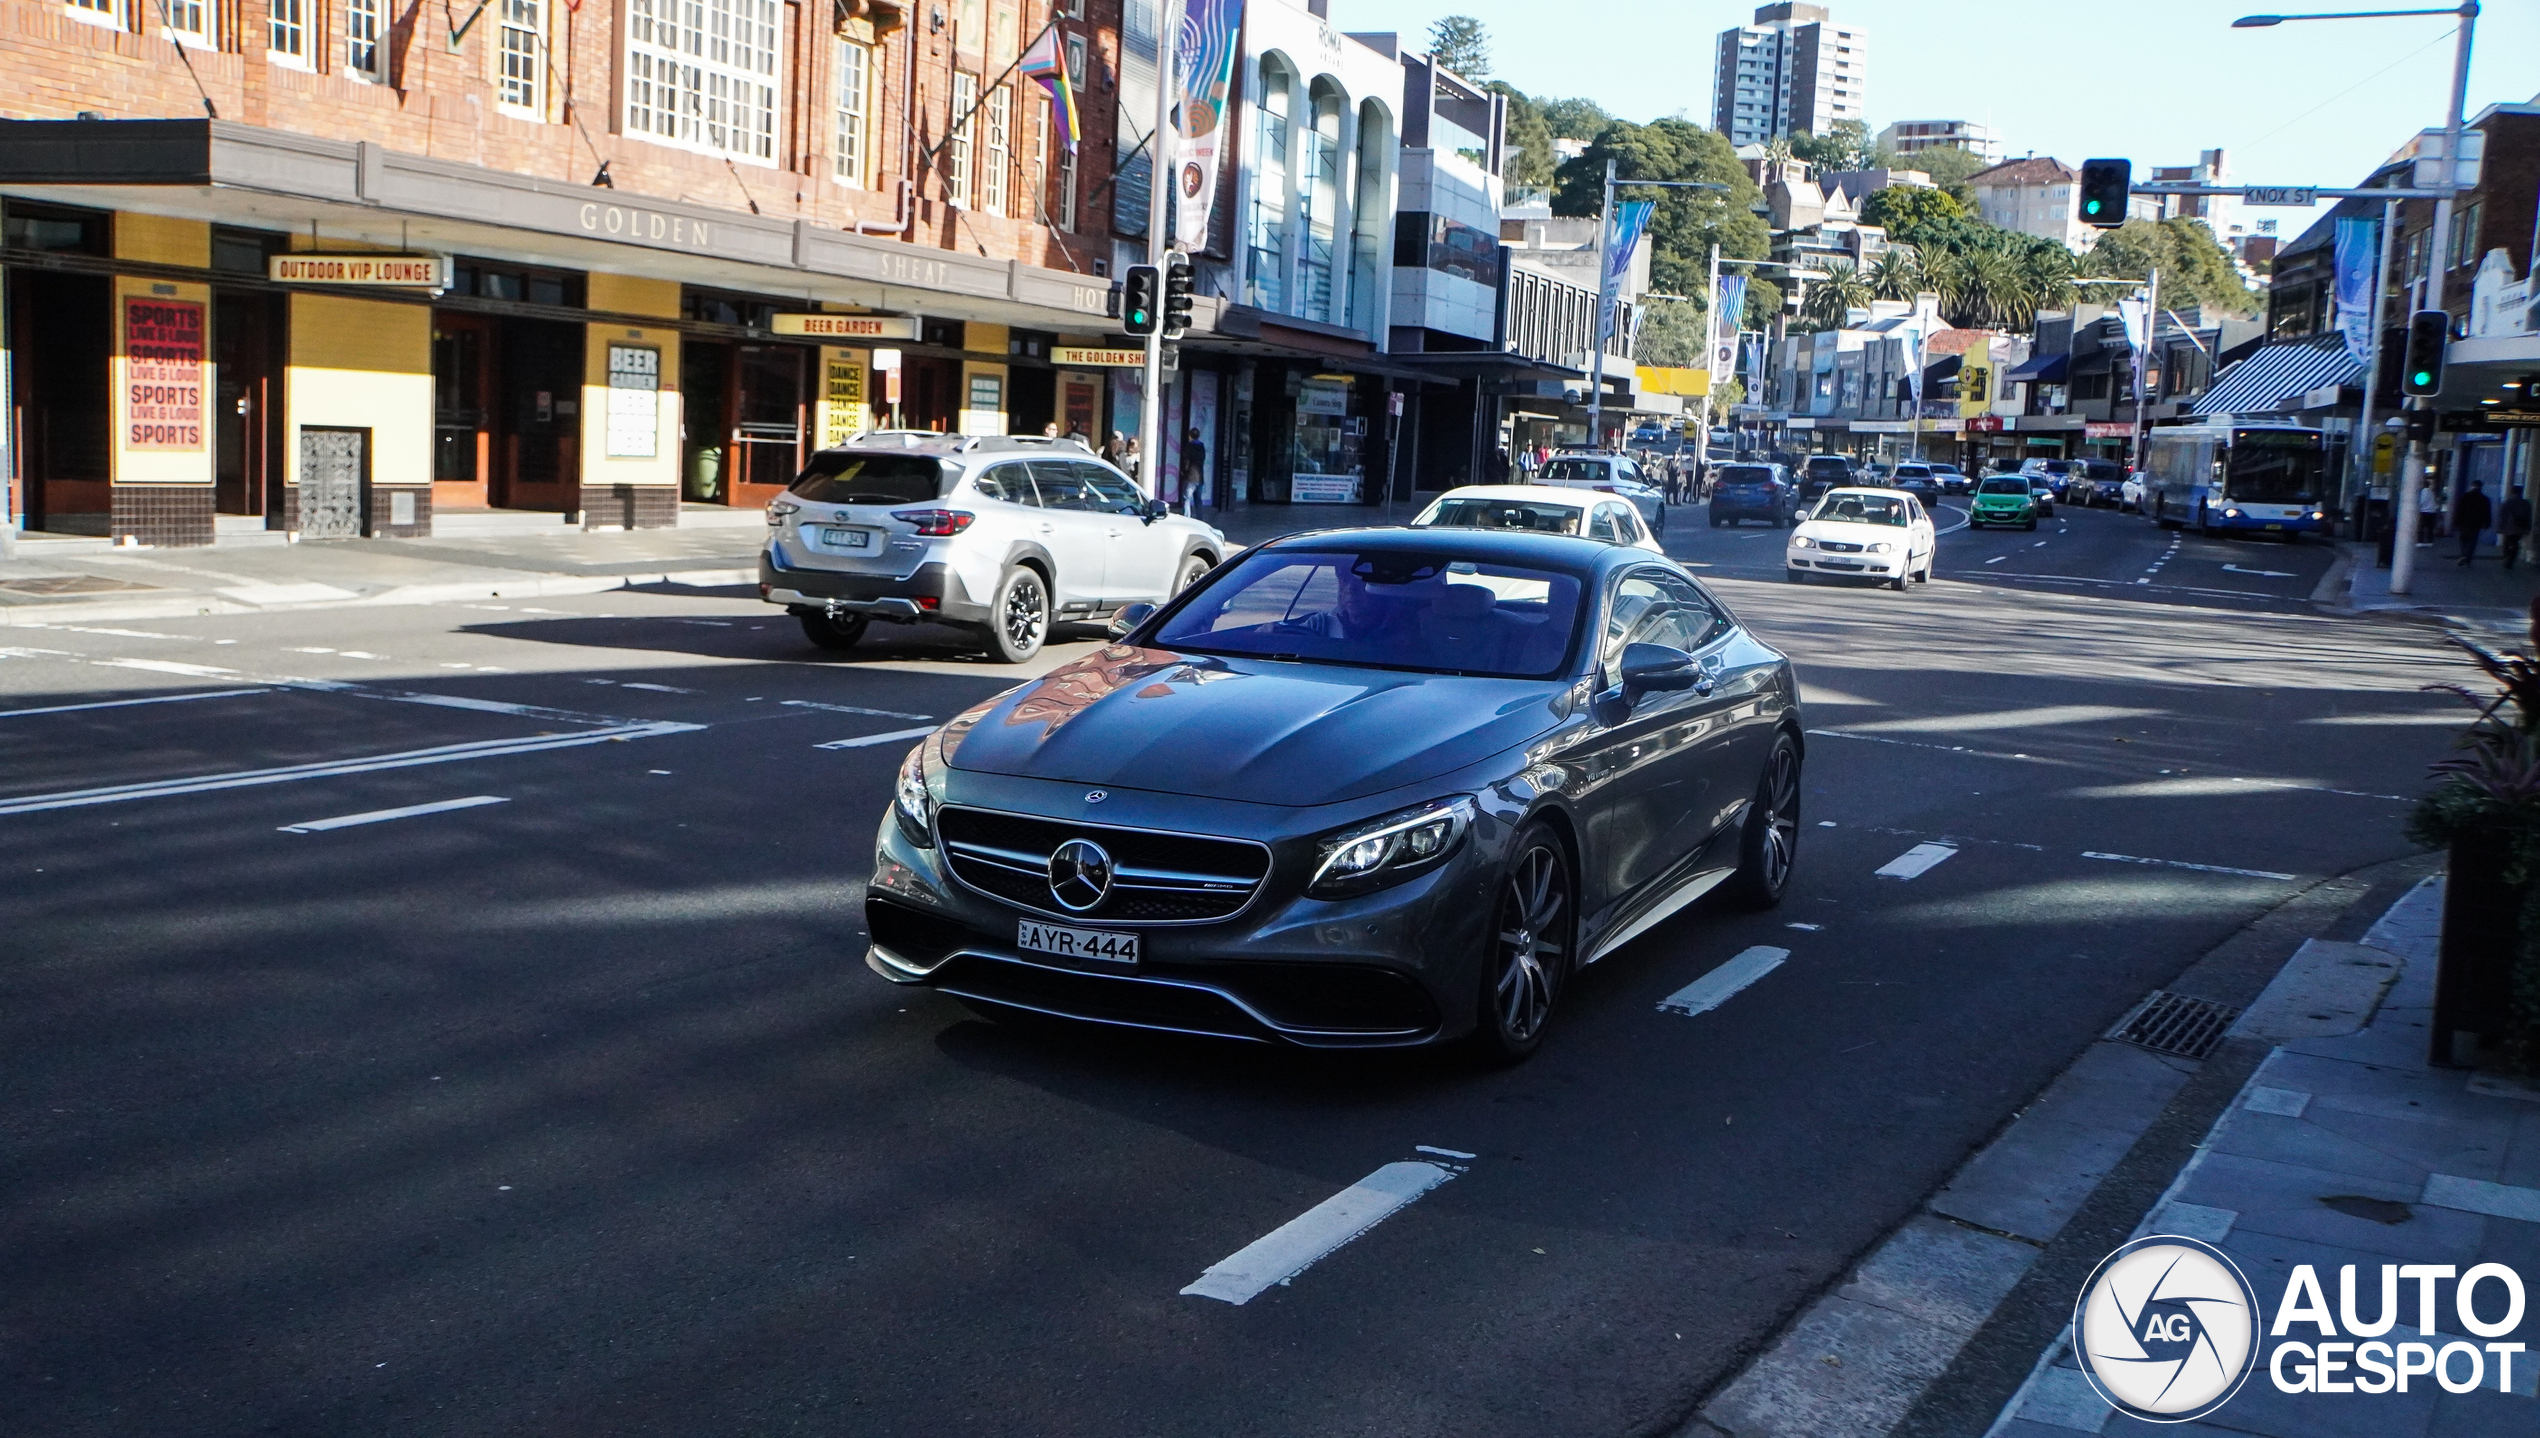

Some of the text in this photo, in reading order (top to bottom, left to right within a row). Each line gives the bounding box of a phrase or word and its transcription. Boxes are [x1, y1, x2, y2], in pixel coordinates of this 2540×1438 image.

[1318, 25, 1342, 55] ROMA
[2245, 188, 2315, 204] KNOX ST
[579, 203, 709, 246] GOLDEN
[280, 260, 432, 281] OUTDOOR VIP LOUNGE
[880, 253, 947, 284] SHEAF
[129, 304, 199, 329] SPORTS
[130, 325, 199, 343] LIVE & LOUD
[804, 319, 883, 334] BEER GARDEN
[130, 344, 199, 367] SPORTS
[1066, 351, 1083, 362] THE
[1086, 352, 1125, 364] GOLDEN
[130, 366, 199, 382] LIVE & LOUD
[829, 364, 859, 381] DANCE
[131, 384, 199, 406] SPORTS
[829, 381, 859, 397] DANCE
[829, 397, 859, 412] DANCE
[130, 406, 199, 421] LIVE & LOUD
[829, 413, 859, 428] DANCE
[131, 424, 199, 444] SPORTS
